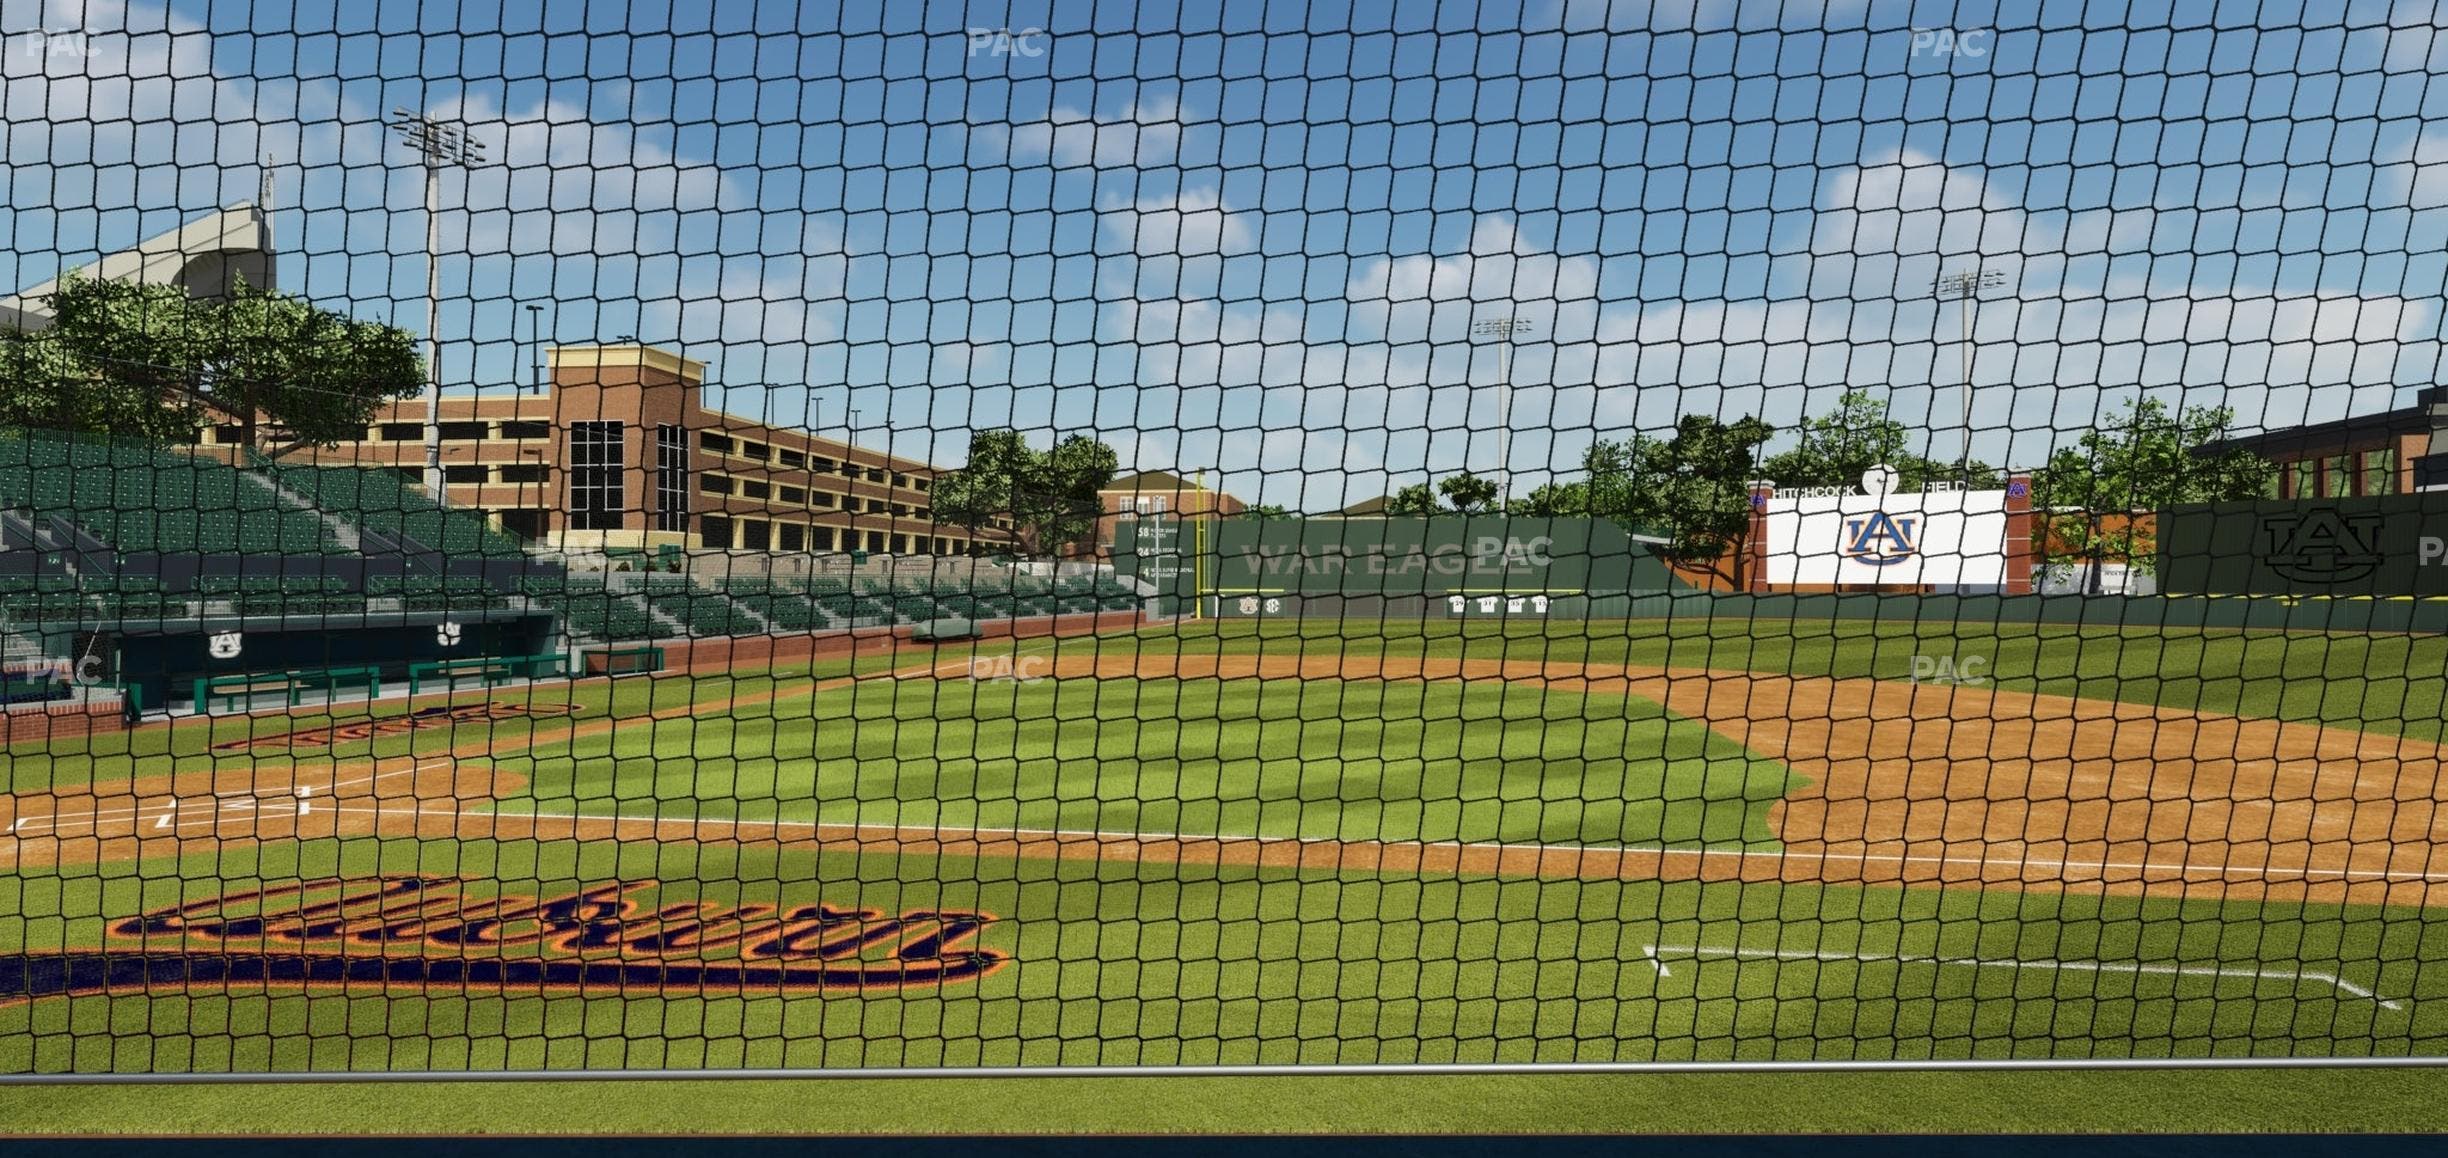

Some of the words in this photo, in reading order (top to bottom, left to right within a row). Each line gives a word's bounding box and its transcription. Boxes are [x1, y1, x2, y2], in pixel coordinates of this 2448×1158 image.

[1773, 485, 1857, 499] HITCHCOCK
[1922, 481, 1968, 495] FIELD
[1241, 544, 1354, 576] WAR
